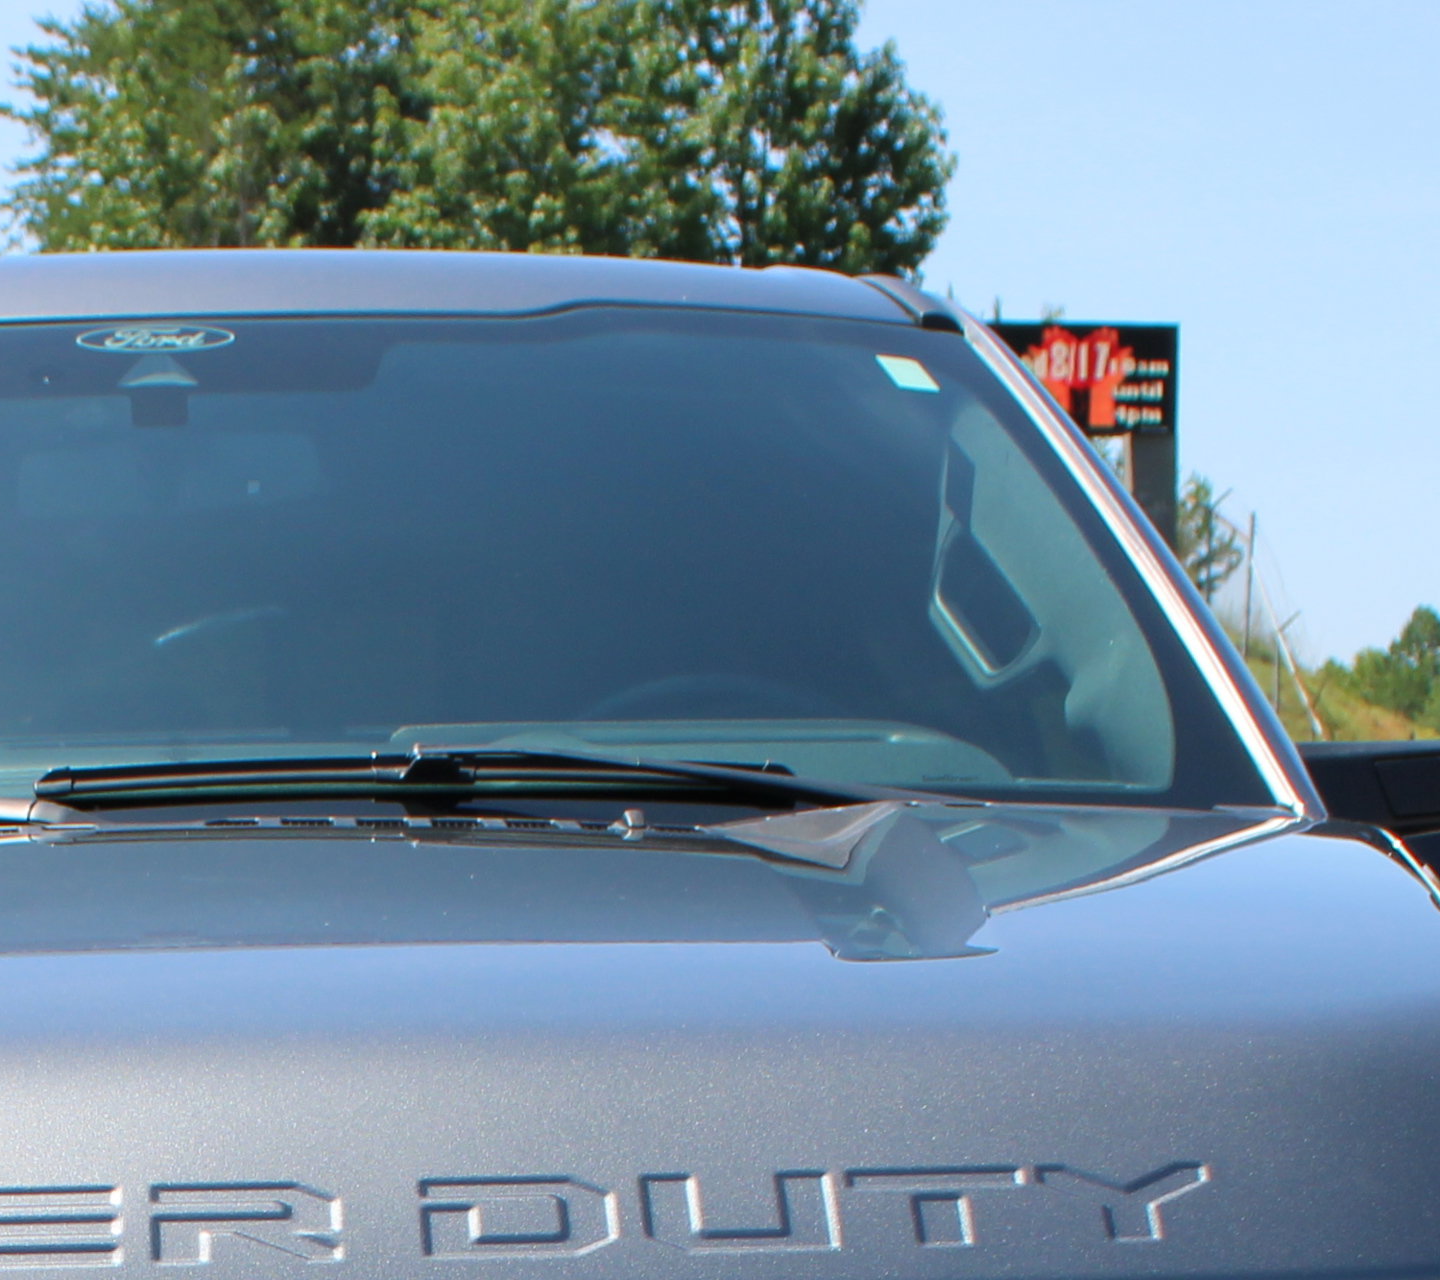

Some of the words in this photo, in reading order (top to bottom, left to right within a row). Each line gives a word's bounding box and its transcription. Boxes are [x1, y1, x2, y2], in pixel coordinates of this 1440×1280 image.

[104, 326, 206, 348] Ford
[1050, 339, 1109, 383] 8/17
[417, 1160, 1211, 1259] DUTY
